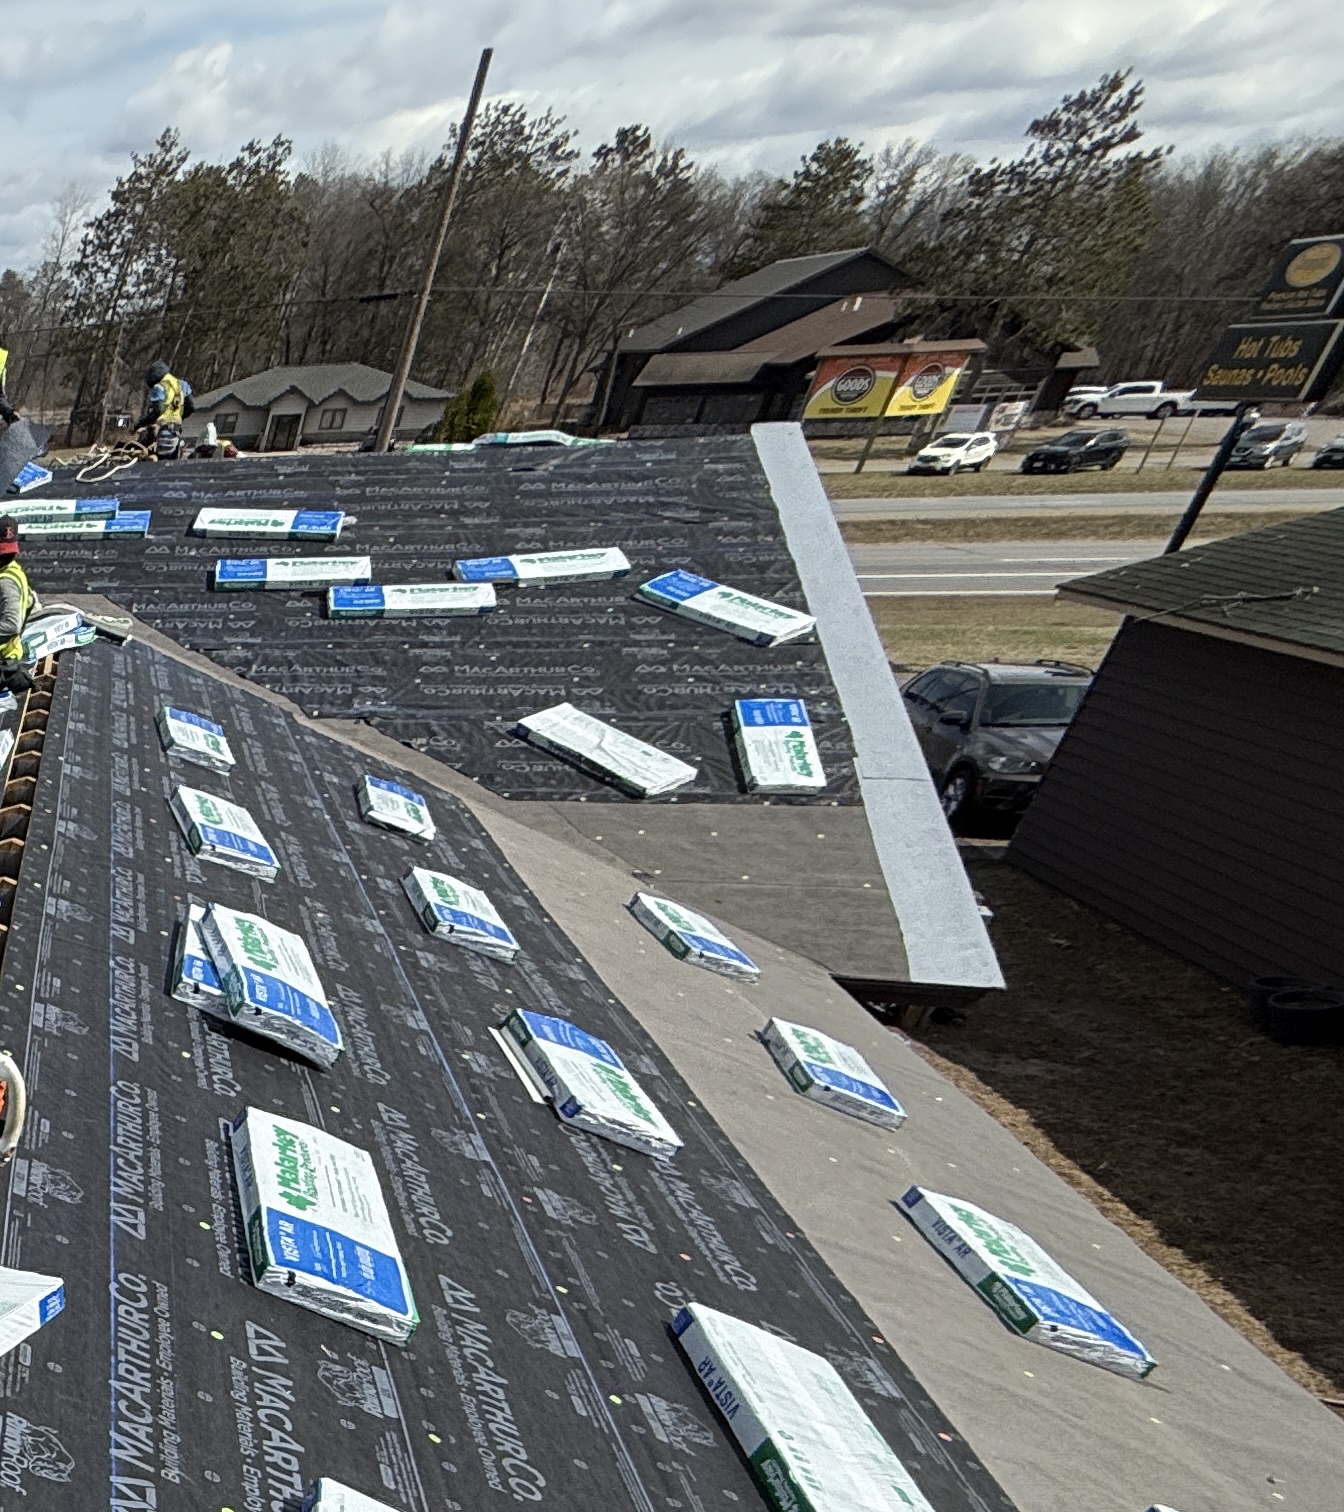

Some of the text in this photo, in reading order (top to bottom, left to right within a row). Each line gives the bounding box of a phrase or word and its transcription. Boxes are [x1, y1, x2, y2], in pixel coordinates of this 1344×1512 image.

[1202, 362, 1310, 386] Saunas Pools
[1233, 335, 1303, 359] Hot Tubs
[111, 1273, 156, 1473] MACARTHURCO.
[156, 1319, 176, 1373] Employee
[159, 1374, 180, 1432] Materials
[452, 1315, 547, 1502] MACARTHURCO.
[161, 1433, 183, 1484] Building
